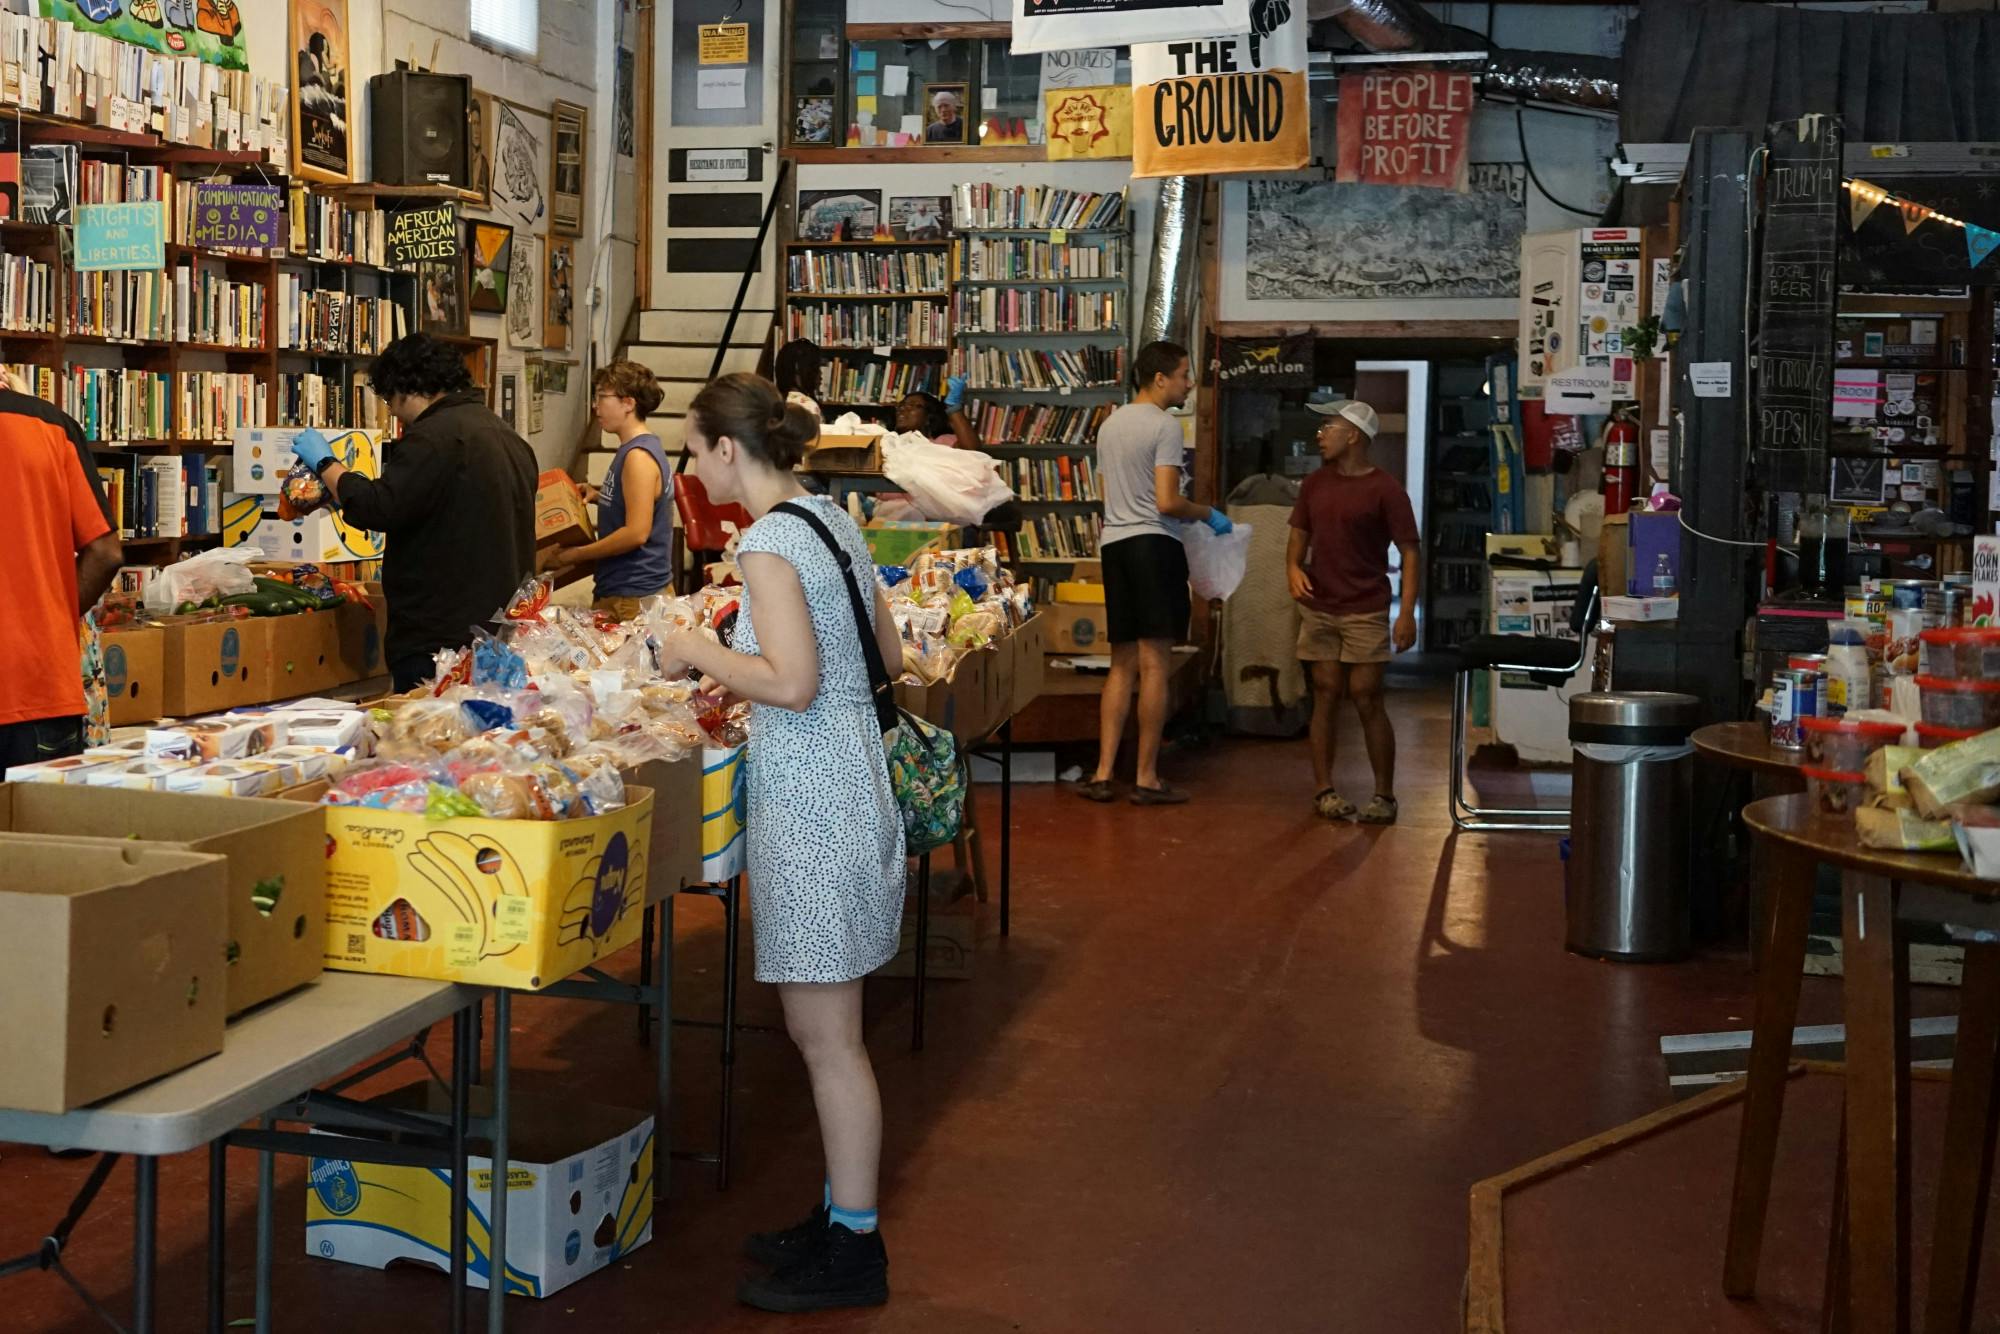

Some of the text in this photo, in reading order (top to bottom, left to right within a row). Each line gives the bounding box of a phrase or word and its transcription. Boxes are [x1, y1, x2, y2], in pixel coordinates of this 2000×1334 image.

[1047, 50, 1113, 69] NO NAZIS
[1168, 40, 1238, 75] THE
[1363, 74, 1467, 111] PEOPLE
[1154, 74, 1284, 147] GROUND
[1365, 113, 1453, 140] BEFORE
[1361, 143, 1453, 175] PROFIT
[1773, 166, 1833, 199] TRULY 4
[198, 190, 278, 210] COMMUNICATIONS
[86, 206, 155, 227] RIGHTS
[230, 206, 240, 220] &
[394, 206, 452, 231] AFRICAN
[105, 228, 128, 240] AND
[202, 224, 258, 241] MEDIA
[387, 223, 456, 246] AMERICAN
[395, 240, 456, 261] STUDIES
[1770, 280, 1812, 297] BEER
[1819, 267, 1831, 293] 4
[1551, 378, 1610, 388] RESTROOM
[1761, 409, 1807, 445] PEPSI
[1974, 552, 1999, 569] CORN
[1974, 568, 1999, 583] FLAKES
[312, 1159, 350, 1184] Chiquita
